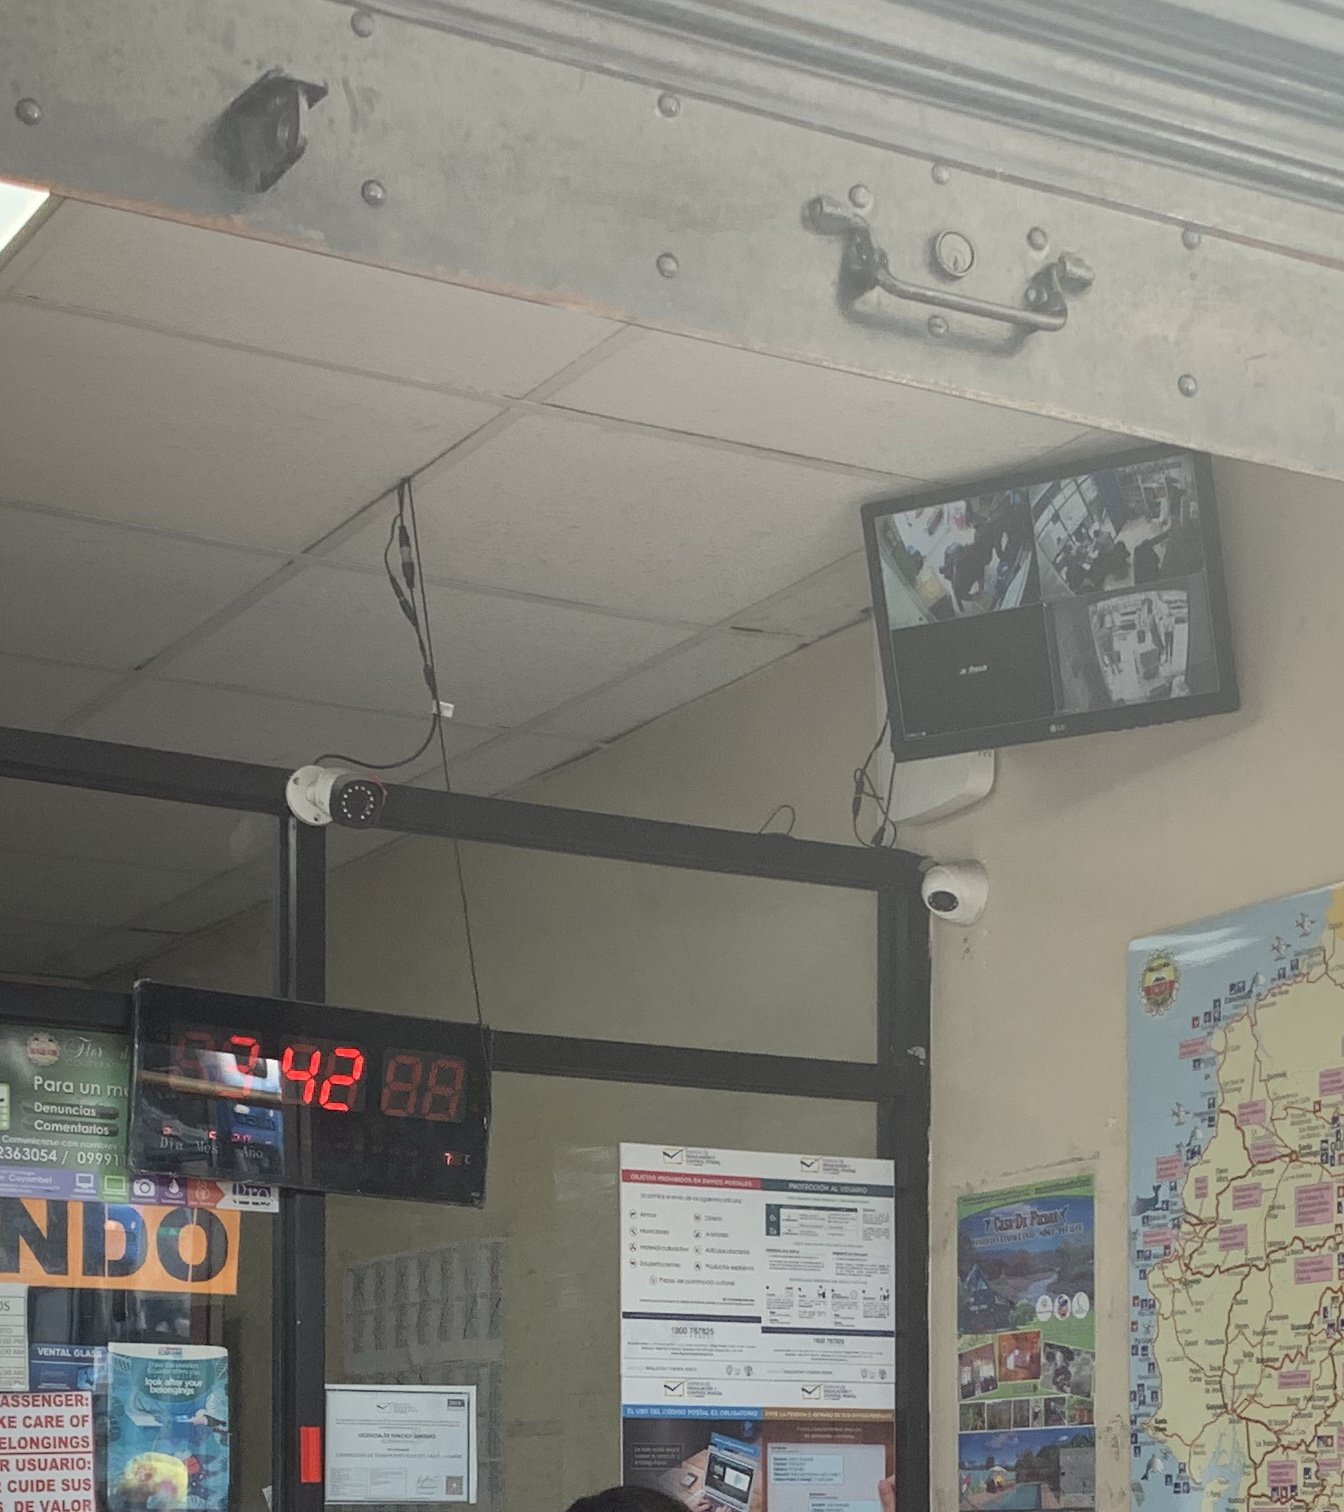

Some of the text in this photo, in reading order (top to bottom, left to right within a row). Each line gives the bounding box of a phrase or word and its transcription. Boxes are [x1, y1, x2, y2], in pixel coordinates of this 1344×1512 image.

[33, 1076, 76, 1095] Para
[80, 1082, 101, 1096] un
[34, 1102, 96, 1118] Denuncias
[34, 1120, 109, 1136] Comentarios
[37, 1347, 72, 1357] VENTAL
[145, 1377, 202, 1388] look after your
[150, 1386, 194, 1395] belongings
[22, 1415, 64, 1428] CARE
[69, 1415, 89, 1428] OF
[16, 1458, 91, 1471] USUARIO:
[7, 1480, 56, 1493] CUIDE
[61, 1479, 91, 1491] SUS
[14, 1500, 33, 1512] DE
[40, 1500, 92, 1512] VALOR
